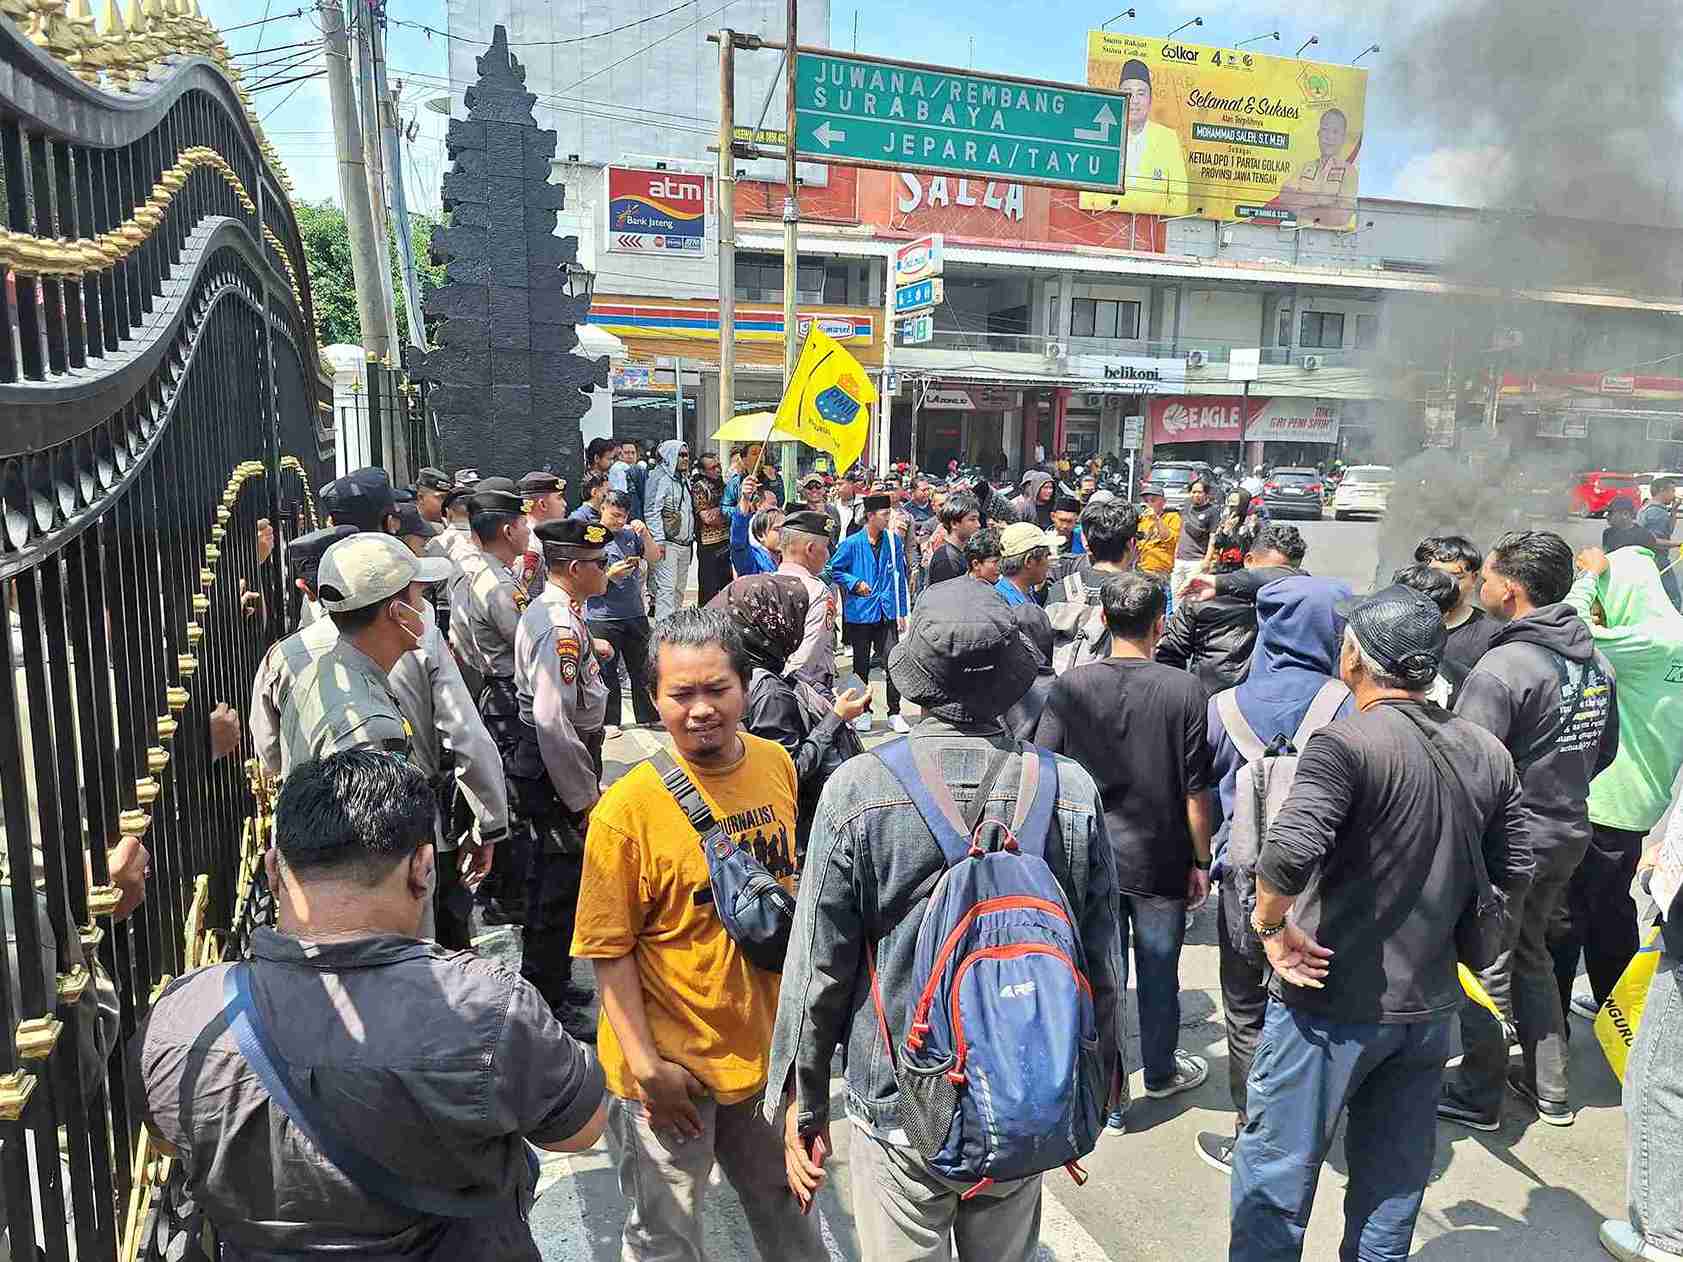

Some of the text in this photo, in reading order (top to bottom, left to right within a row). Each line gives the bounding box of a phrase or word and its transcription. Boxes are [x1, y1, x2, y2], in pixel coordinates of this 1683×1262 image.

[1161, 44, 1199, 62] Golkar
[814, 62, 1065, 114] JUWANA/REMBANG
[813, 86, 1006, 131] SURABAYA
[1187, 88, 1244, 111] Selamat
[1244, 96, 1256, 114] &
[1256, 98, 1300, 120] Sukses
[1196, 125, 1235, 141] MOHAMMAD
[883, 132, 1101, 175] JEPARA/TAYU
[1188, 151, 1213, 166] KETUA
[1236, 156, 1261, 170] PARTAI
[1261, 159, 1290, 173] GOLKAR
[1200, 166, 1278, 185] PROVINSI JAWA TENGAH
[648, 176, 703, 200] atm
[626, 215, 648, 225] Bank
[1188, 406, 1240, 429] EAGLE
[716, 804, 777, 836] OURNALIST
